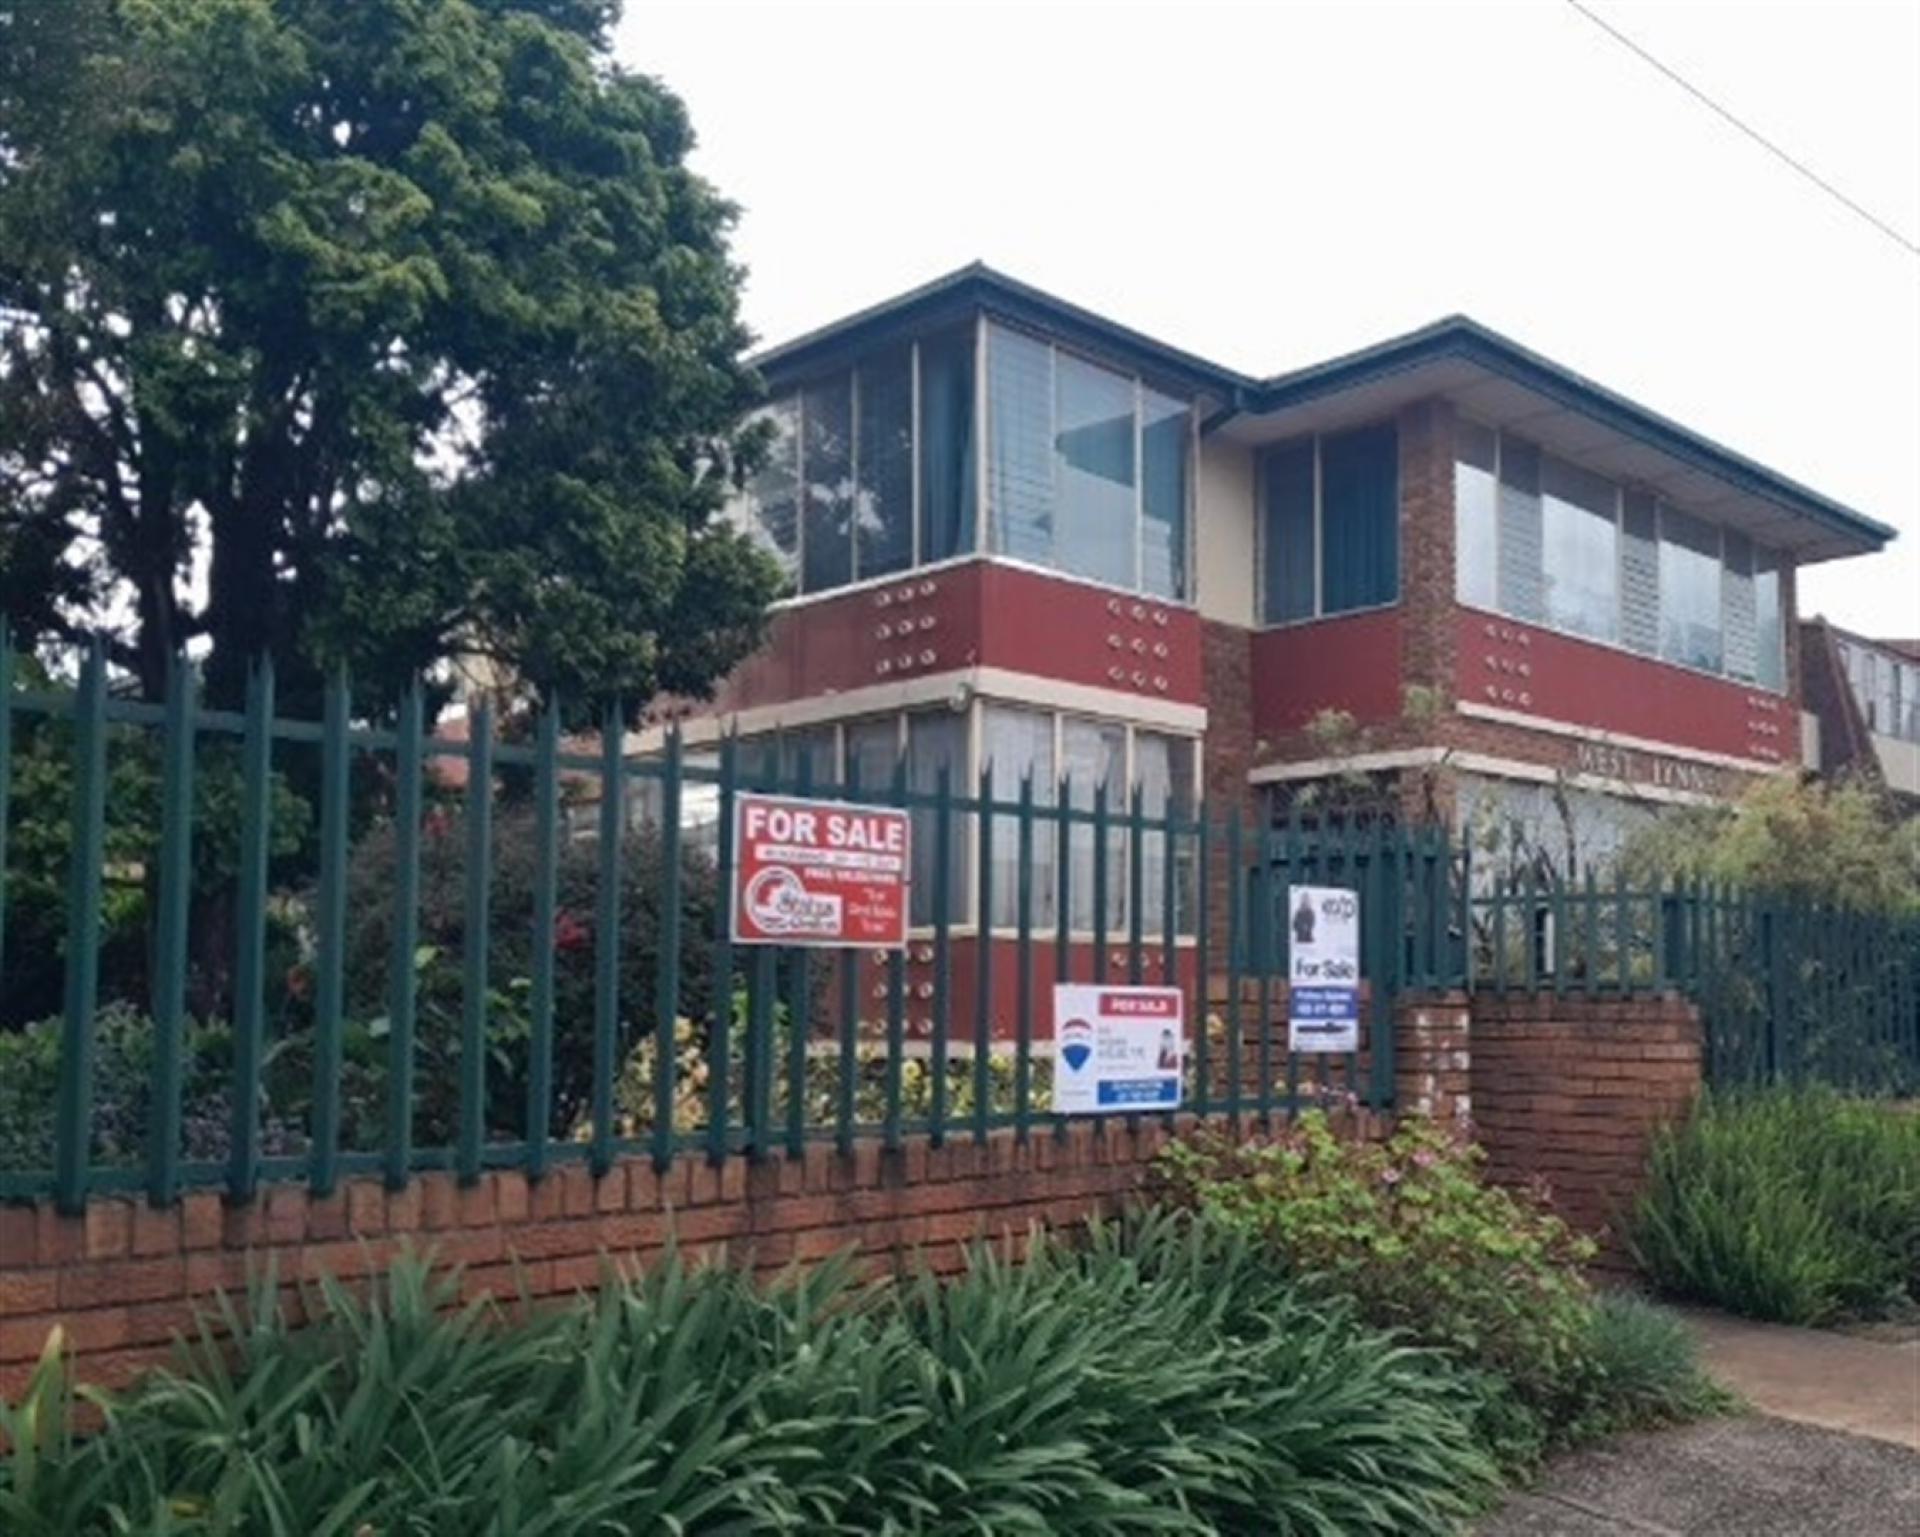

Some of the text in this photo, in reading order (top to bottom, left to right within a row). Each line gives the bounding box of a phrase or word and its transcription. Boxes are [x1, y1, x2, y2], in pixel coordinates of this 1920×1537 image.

[1577, 743, 1633, 778] WEST
[746, 807, 904, 851] FOR SALE
[1296, 957, 1355, 980] For Sale
